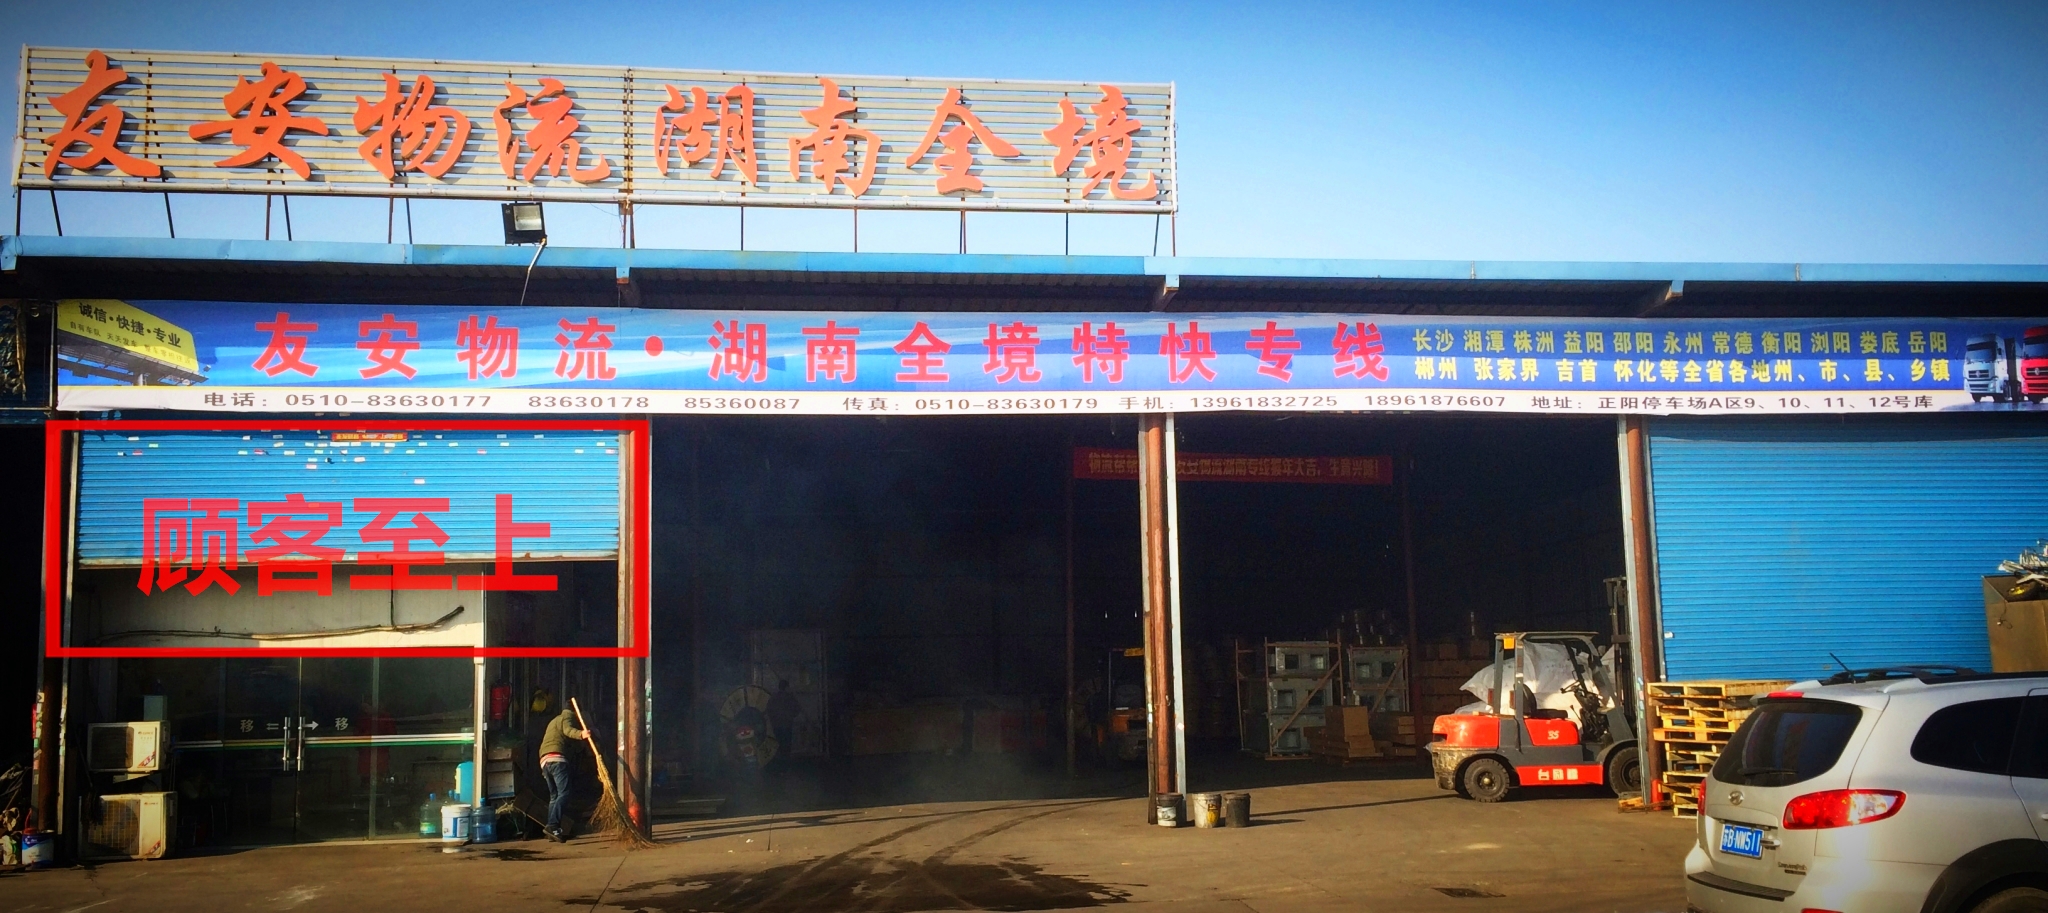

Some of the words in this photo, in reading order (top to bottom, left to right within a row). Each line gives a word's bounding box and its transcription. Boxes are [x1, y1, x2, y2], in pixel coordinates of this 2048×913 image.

[44, 49, 610, 182] 友安物流
[653, 77, 1158, 200] 湖南全境
[79, 302, 182, 349] 诚信·快捷·专业
[252, 312, 1389, 382] 友安物流·湖南全境特快专线
[1413, 329, 1455, 353] 长沙
[1463, 329, 1504, 353] 湘潭
[1513, 329, 1554, 353] 株洲
[1563, 330, 1604, 353] 益阳
[1613, 330, 1654, 353] 邵阳
[1663, 330, 1704, 353] 永州
[1712, 331, 1753, 353] 常德
[1761, 331, 1802, 353] 衡阳
[1811, 331, 1851, 353] 浏阳
[1860, 332, 1900, 353] 娄底
[1908, 332, 1948, 354] 岳阳
[1415, 356, 1458, 381] 郴州
[1473, 357, 1540, 381] 张家界
[1556, 358, 1598, 382] 吉首
[285, 393, 492, 409] 0510-83630177
[528, 395, 650, 409] 83630178
[684, 396, 800, 410] 85360087
[915, 397, 1098, 411] 0510-83630179
[1190, 395, 1338, 409] 13961832725
[1365, 394, 1506, 408] 18961876607
[335, 717, 349, 731] 移
